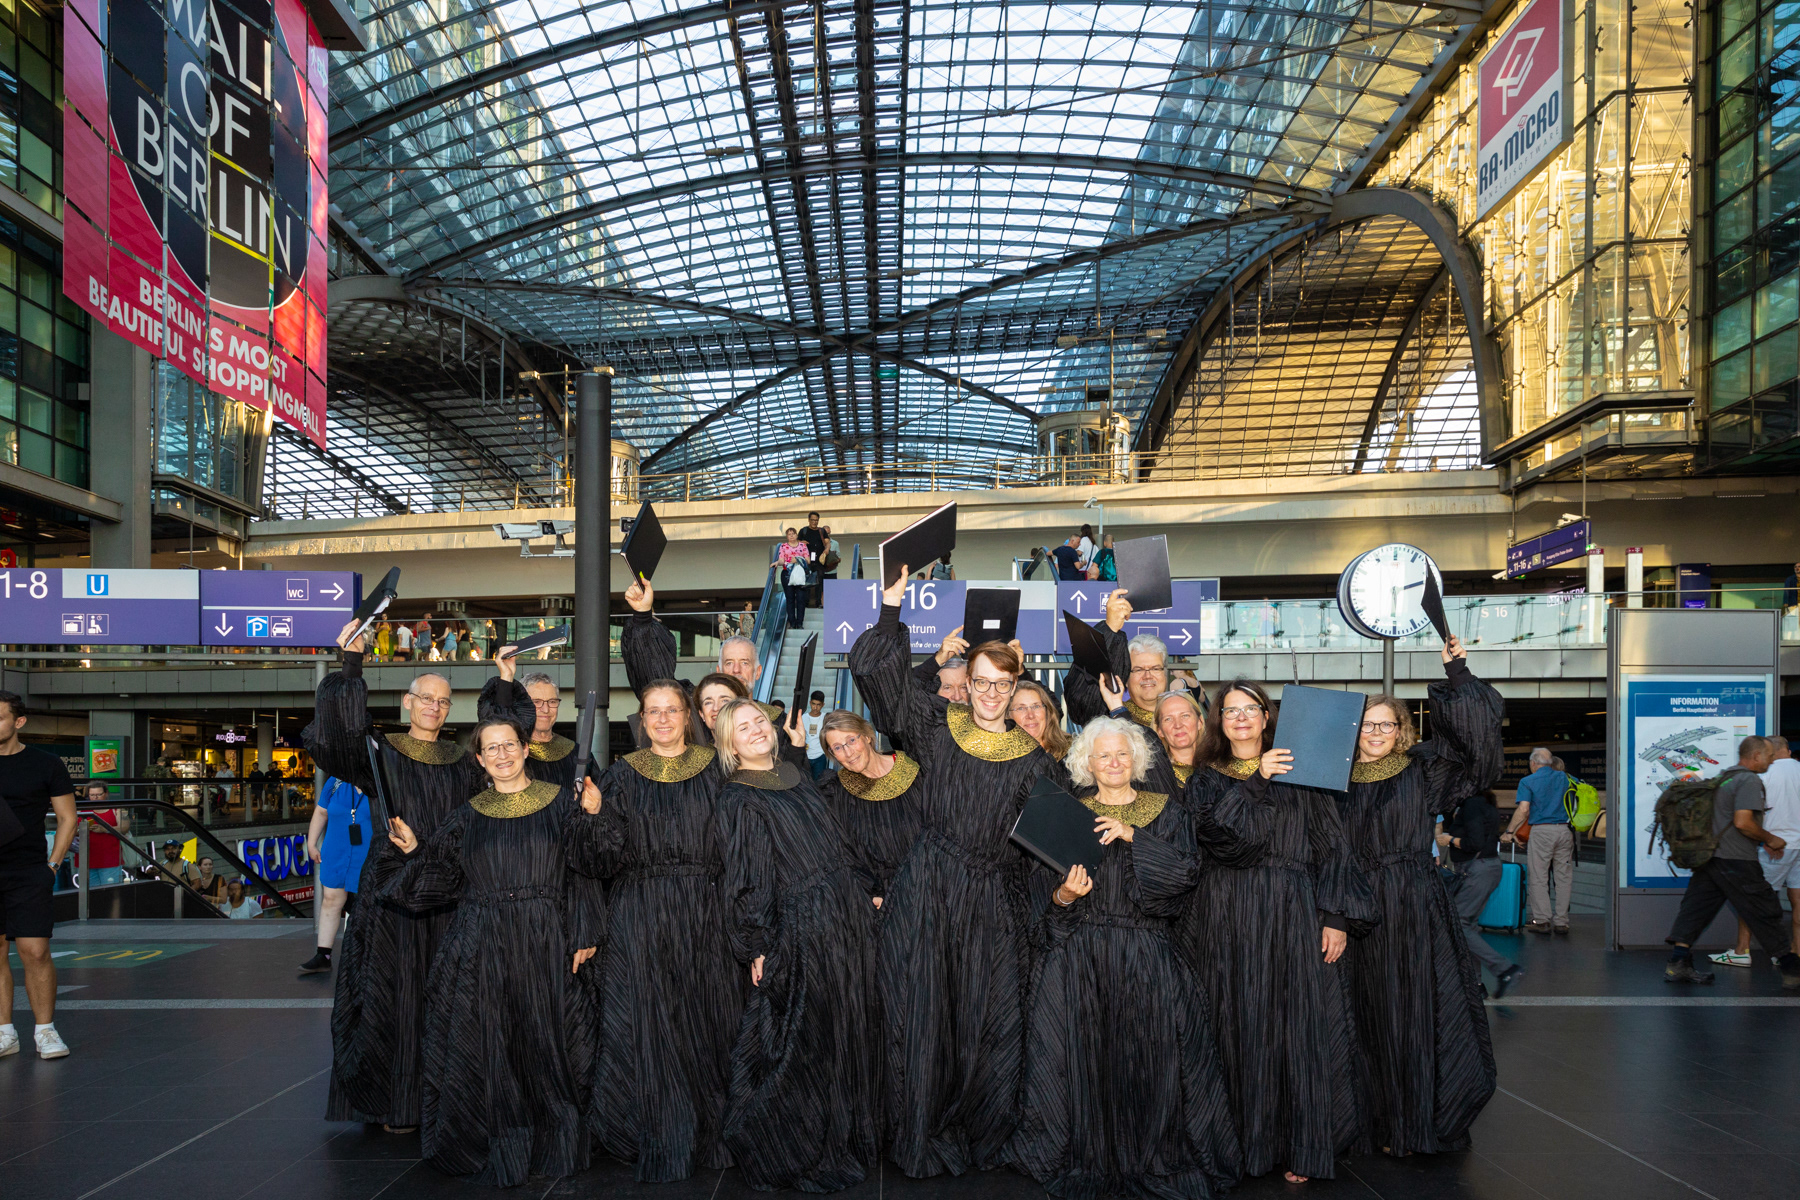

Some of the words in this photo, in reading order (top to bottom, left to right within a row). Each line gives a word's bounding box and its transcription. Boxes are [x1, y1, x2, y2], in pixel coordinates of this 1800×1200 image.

[180, 61, 251, 156] OF
[137, 96, 291, 276] BERLIN
[88, 275, 187, 363] BEAUTIFUL
[229, 338, 288, 384] MOST
[1513, 559, 1527, 572] 11-16
[0, 571, 49, 599] 1-8
[90, 576, 105, 595] U
[288, 589, 305, 599] WC
[1495, 606, 1508, 618] 16
[252, 622, 263, 634] P
[1670, 697, 1719, 706] INFORMATION
